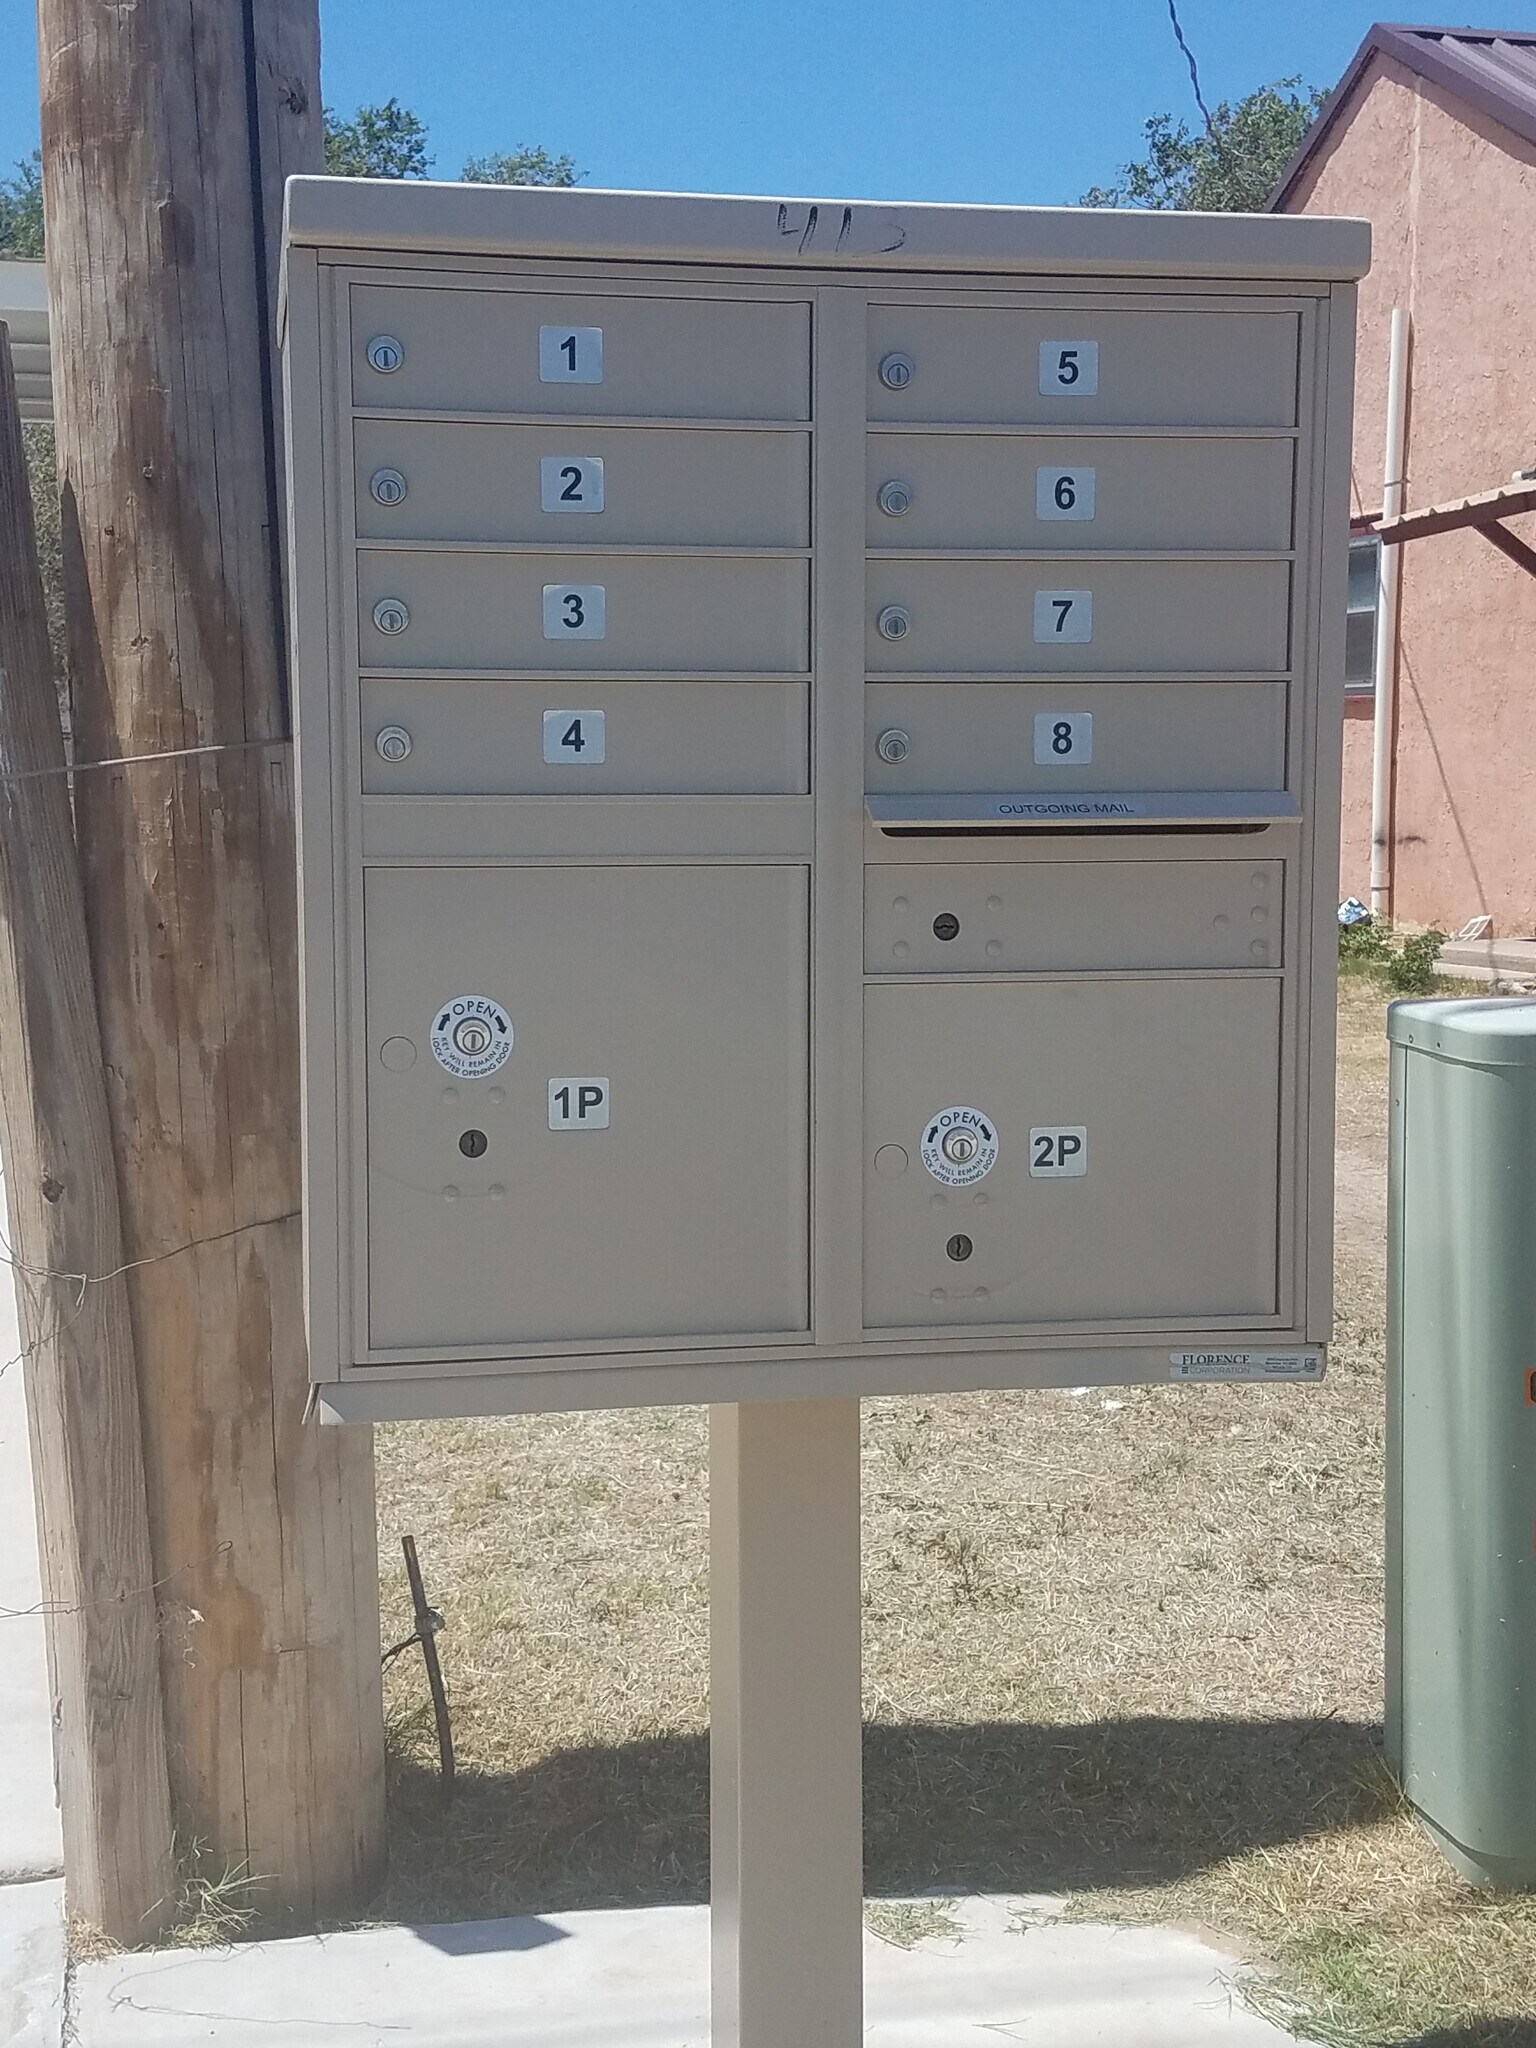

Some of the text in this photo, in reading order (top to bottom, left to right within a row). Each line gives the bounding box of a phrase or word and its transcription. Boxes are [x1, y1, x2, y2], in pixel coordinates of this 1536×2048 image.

[559, 336, 577, 371] 1
[1057, 350, 1079, 385] 5
[559, 467, 584, 500] 2
[1054, 476, 1077, 511] 6
[562, 594, 586, 628] 3
[1051, 599, 1074, 633] 7
[561, 719, 586, 753] 4
[1052, 721, 1074, 755] 8
[999, 803, 1135, 814] OUTGOING MAIL
[452, 1000, 497, 1018] OPEN
[432, 1037, 510, 1077] LOCK AFTER OPENING DOOR
[441, 1037, 502, 1068] KEY WILL REMAIN IN
[554, 1086, 604, 1119] 1P
[939, 1111, 982, 1128] OPEN
[922, 1148, 996, 1185] LOCK AFTER OPENING DOOR
[931, 1148, 988, 1176] KEY WILL REMAIN IN
[1033, 1135, 1082, 1168] 2P
[1182, 1354, 1250, 1366] FLORENCE
[1190, 1366, 1250, 1375] CORPORATION
